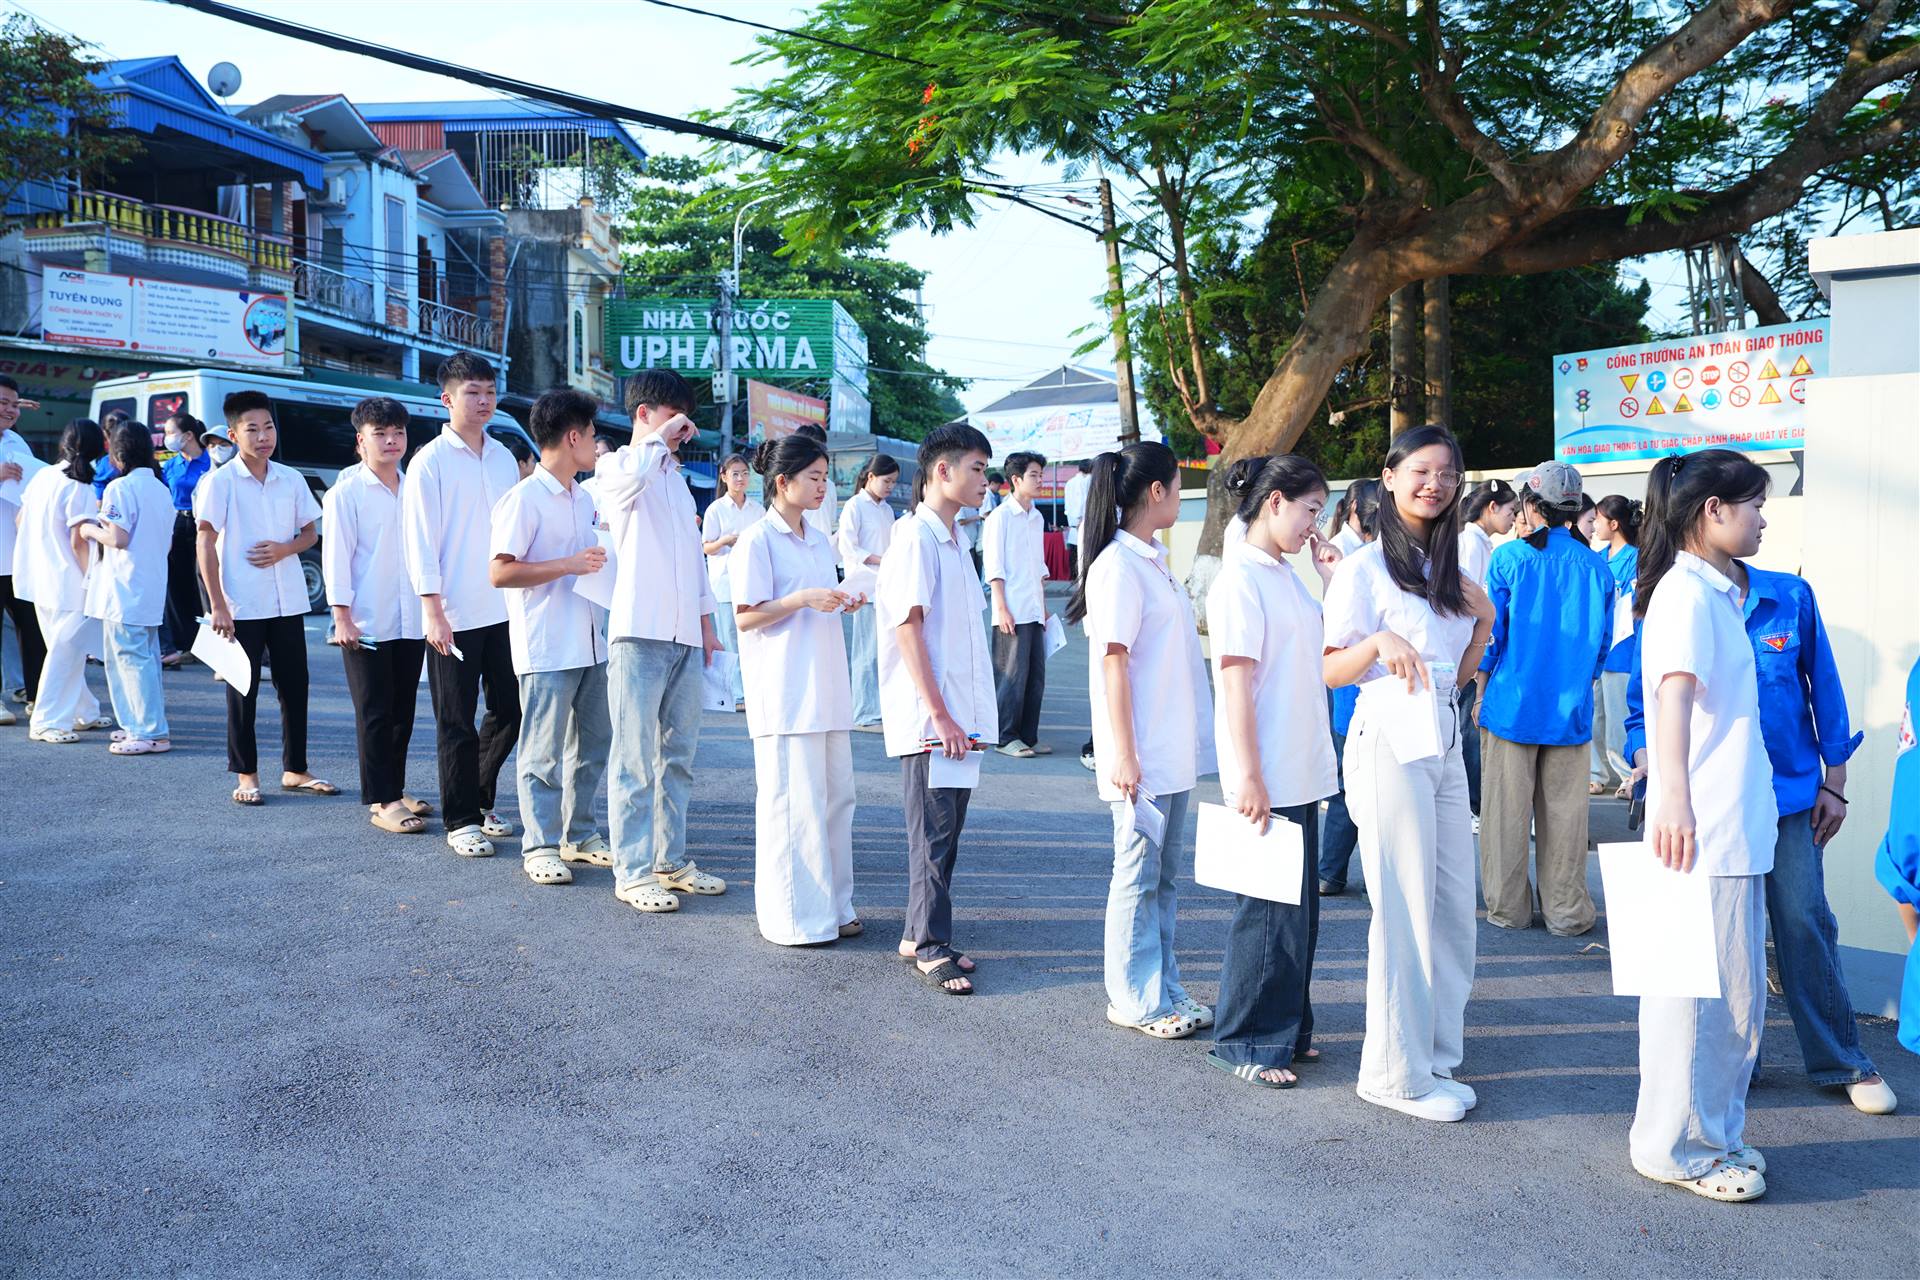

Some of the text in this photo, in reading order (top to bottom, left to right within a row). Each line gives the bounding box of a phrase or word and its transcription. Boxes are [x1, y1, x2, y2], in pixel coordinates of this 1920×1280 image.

[643, 304, 695, 329] NHÀ
[620, 335, 818, 370] UPHARMA
[1688, 344, 1705, 360] AN
[1709, 339, 1741, 356] TOÀN
[1745, 335, 1775, 352] GIAO
[1779, 328, 1823, 348] THÔNG
[1702, 370, 1720, 381] STOP
[1594, 443, 1611, 453] GIAO
